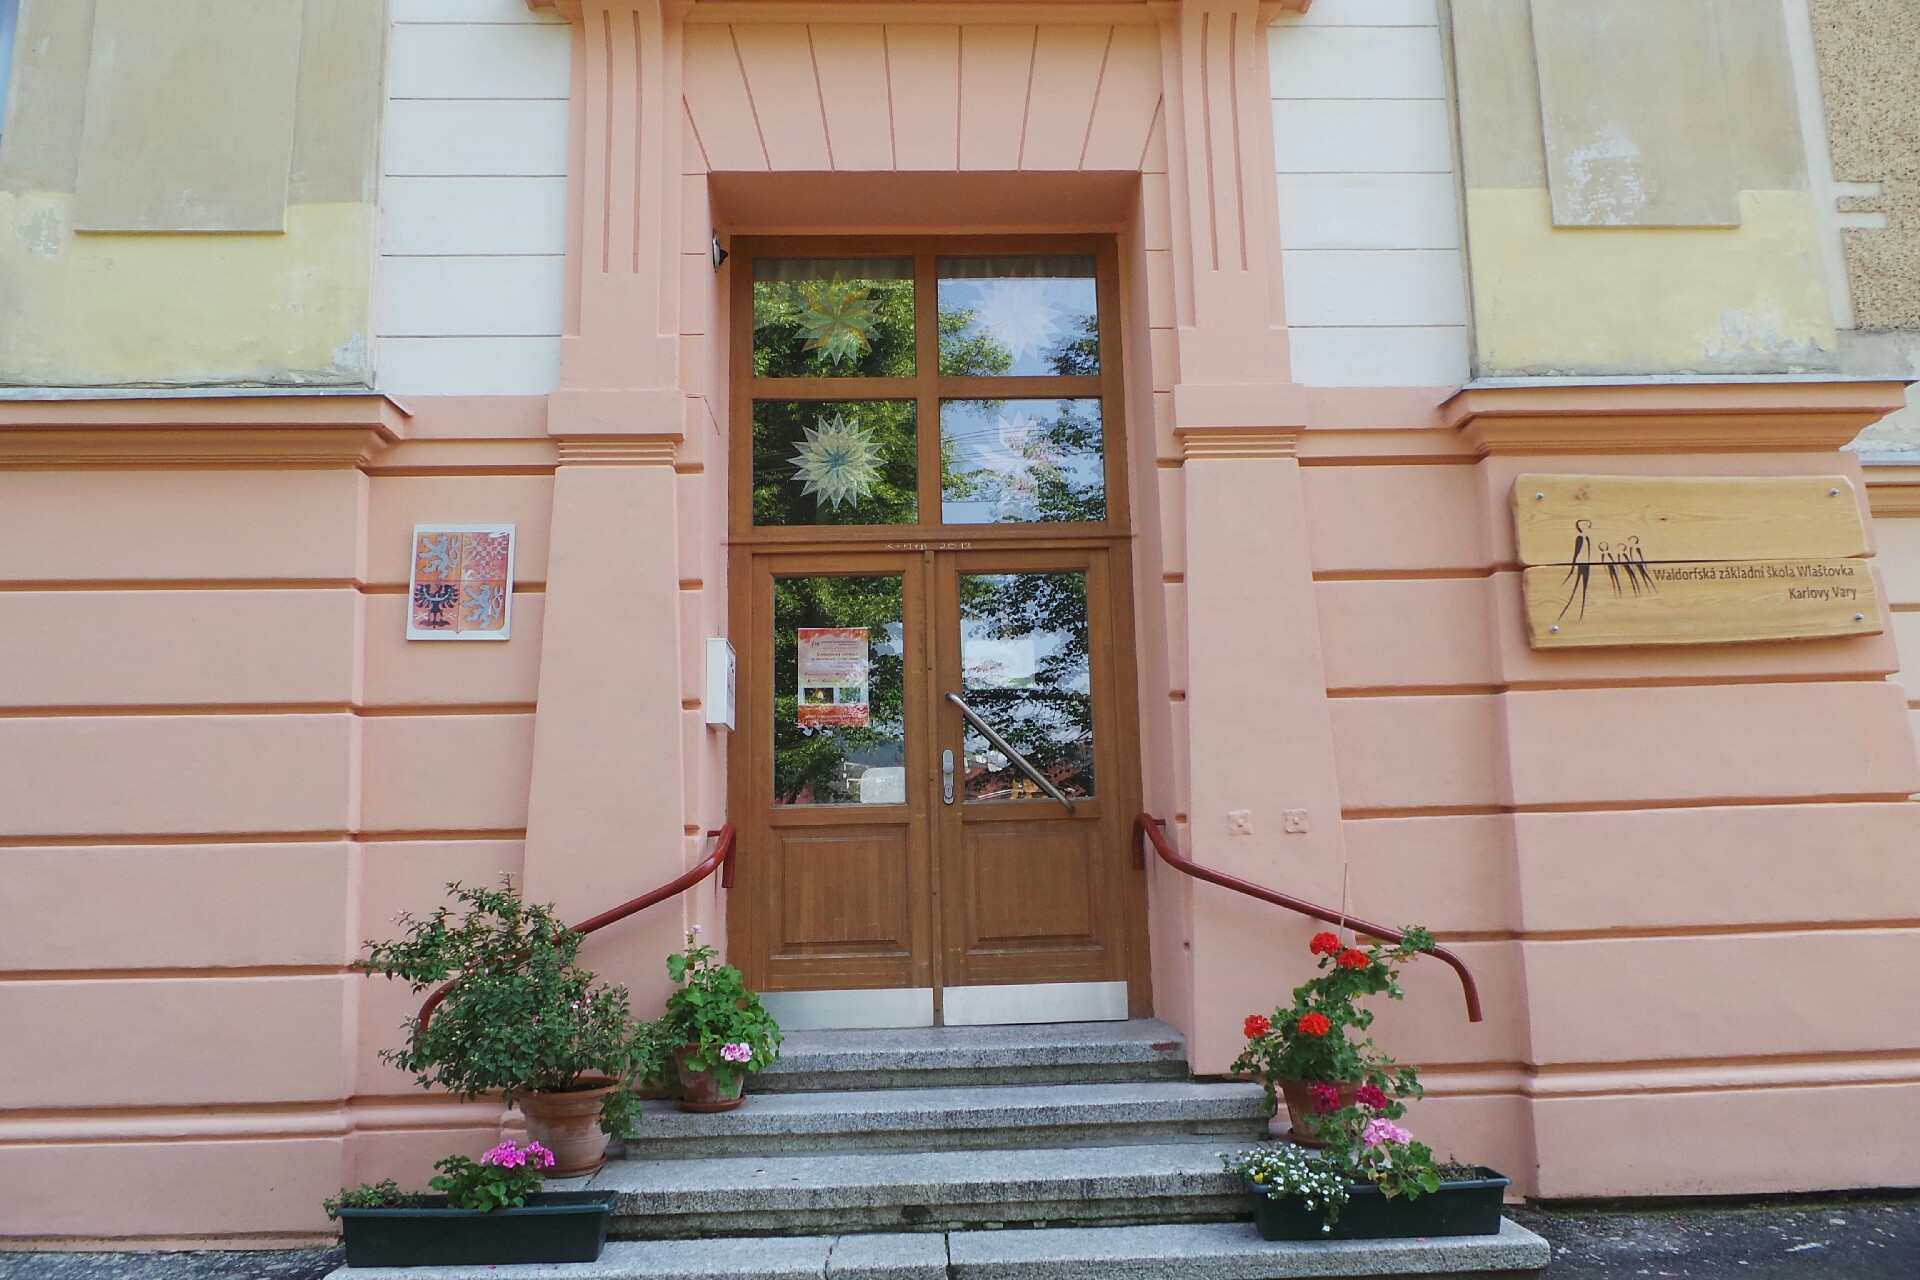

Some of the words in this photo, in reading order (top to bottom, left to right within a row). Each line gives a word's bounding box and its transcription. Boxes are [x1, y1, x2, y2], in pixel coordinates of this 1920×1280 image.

[1653, 567, 1716, 581] Waldorfská
[1718, 566, 1765, 580] základní
[1767, 565, 1795, 579] škola
[1796, 564, 1854, 578] Wlaštovka
[1788, 587, 1829, 602] Karlovy
[1831, 585, 1857, 601] Vary
